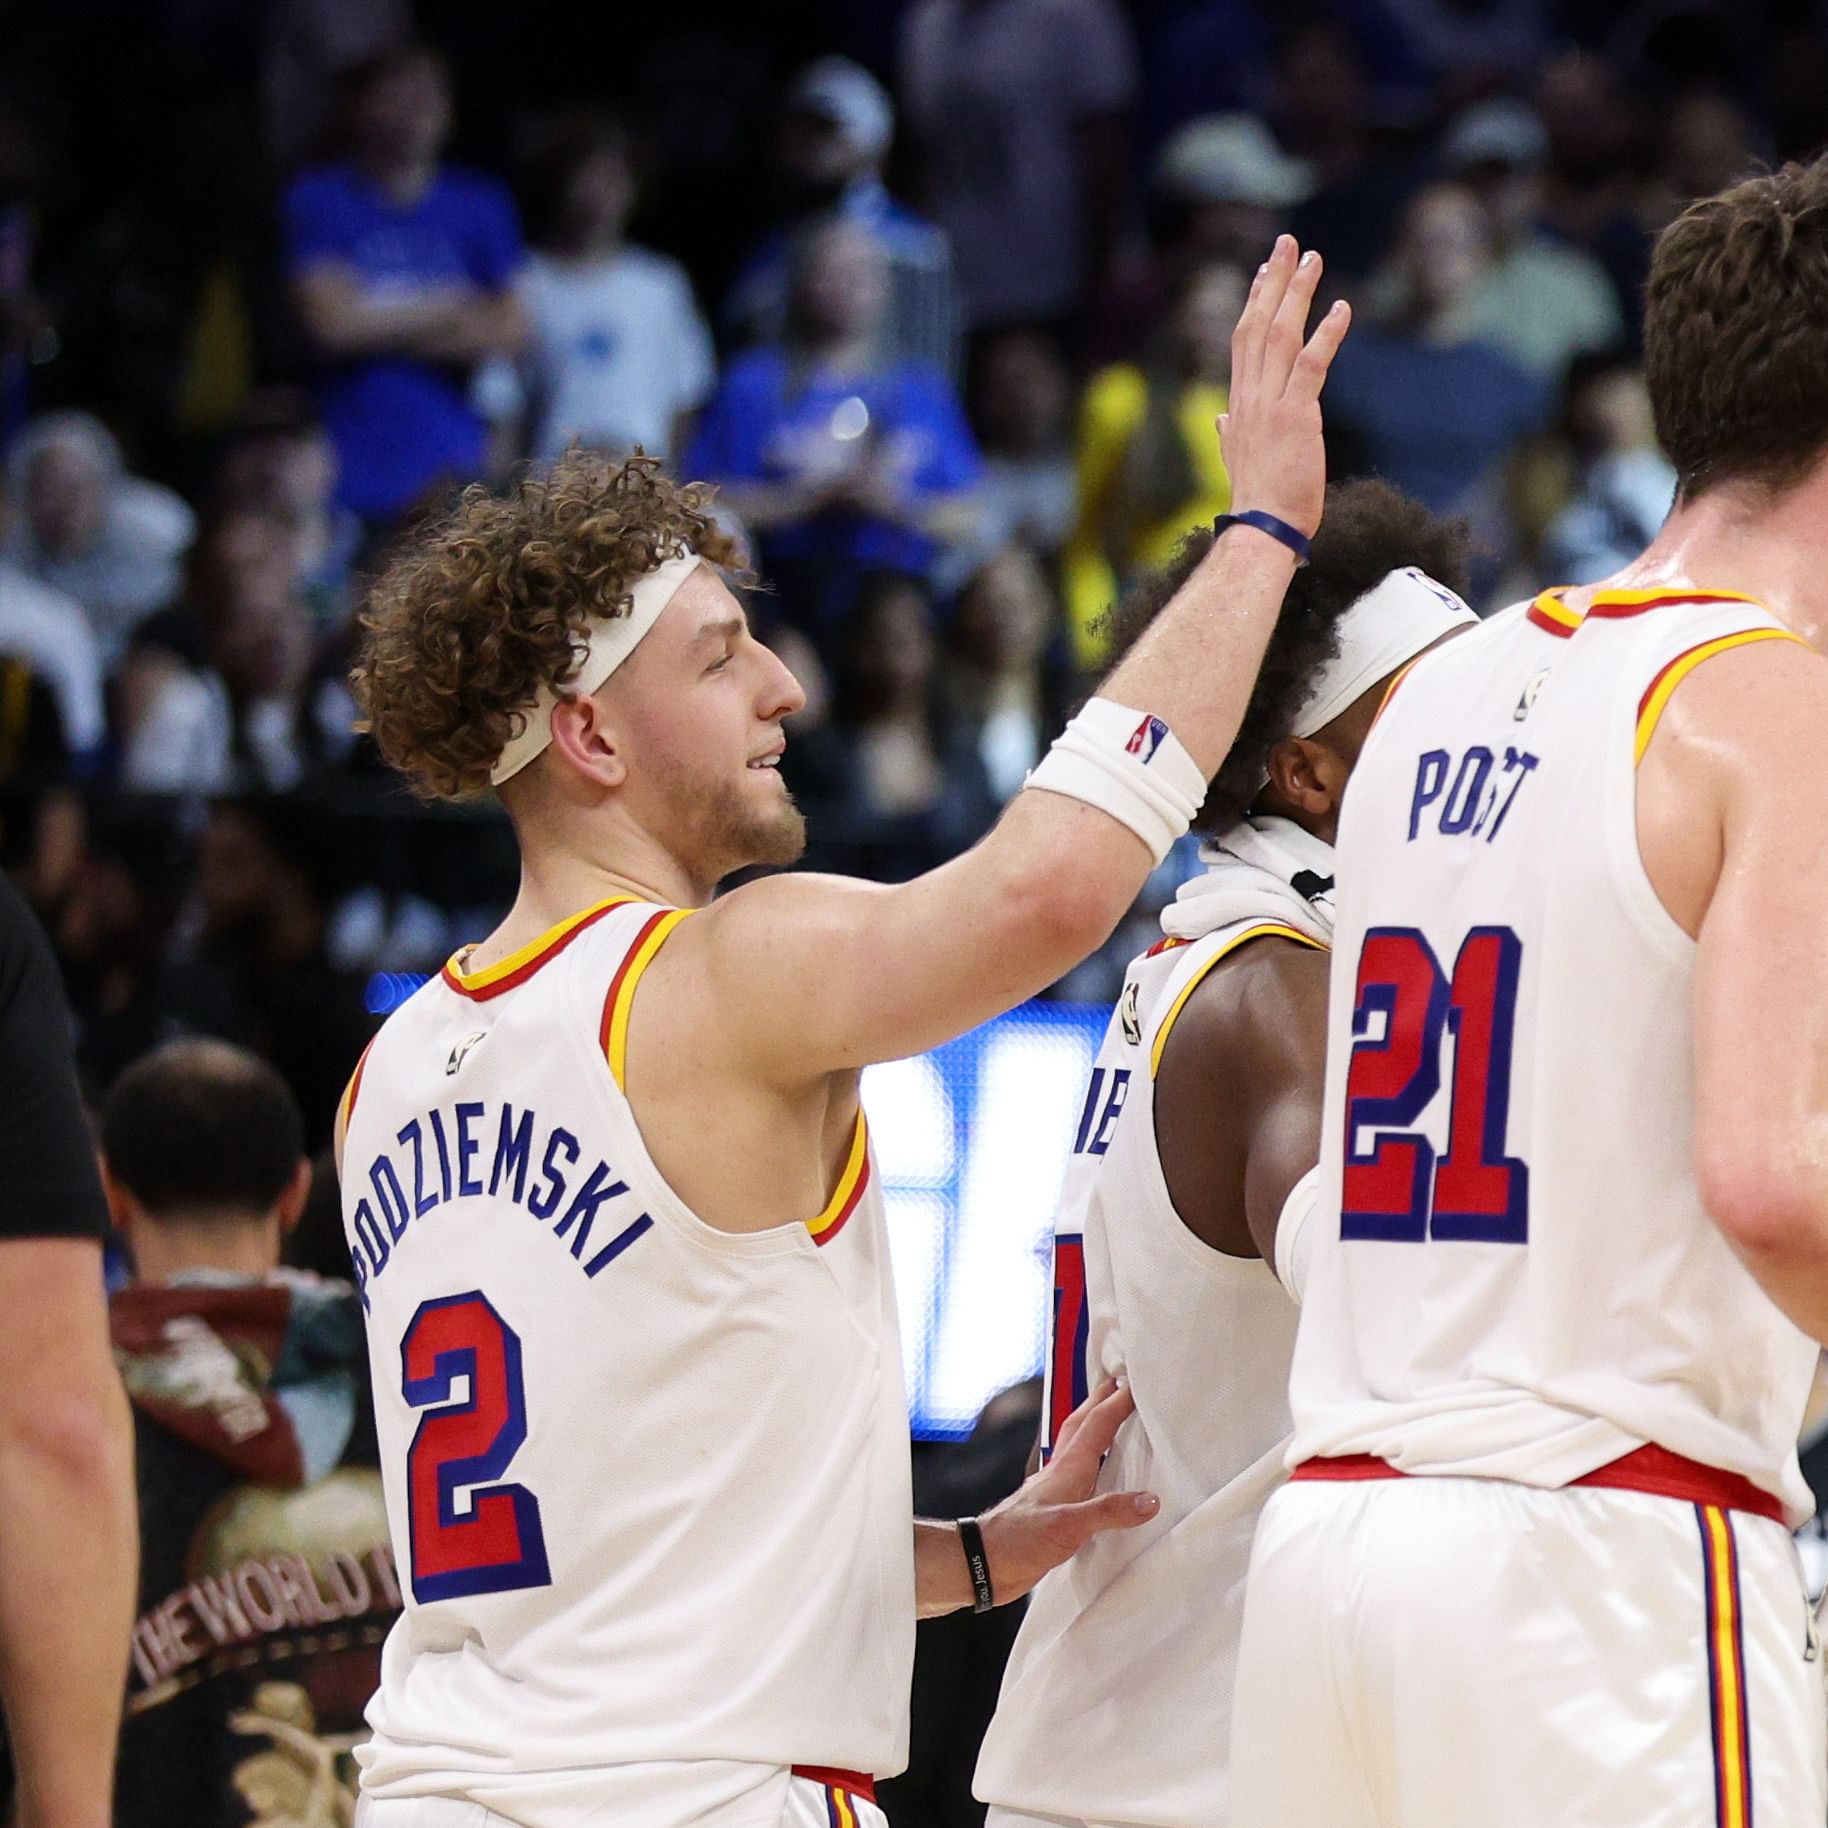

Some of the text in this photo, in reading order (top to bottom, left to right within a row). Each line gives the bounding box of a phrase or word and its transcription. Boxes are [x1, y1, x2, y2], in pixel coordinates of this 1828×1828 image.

[1339, 926, 1529, 1244] 21
[400, 1289, 553, 1606] 2
[188, 1551, 371, 1646] WORLD
[972, 1555, 987, 1584] Jesus
